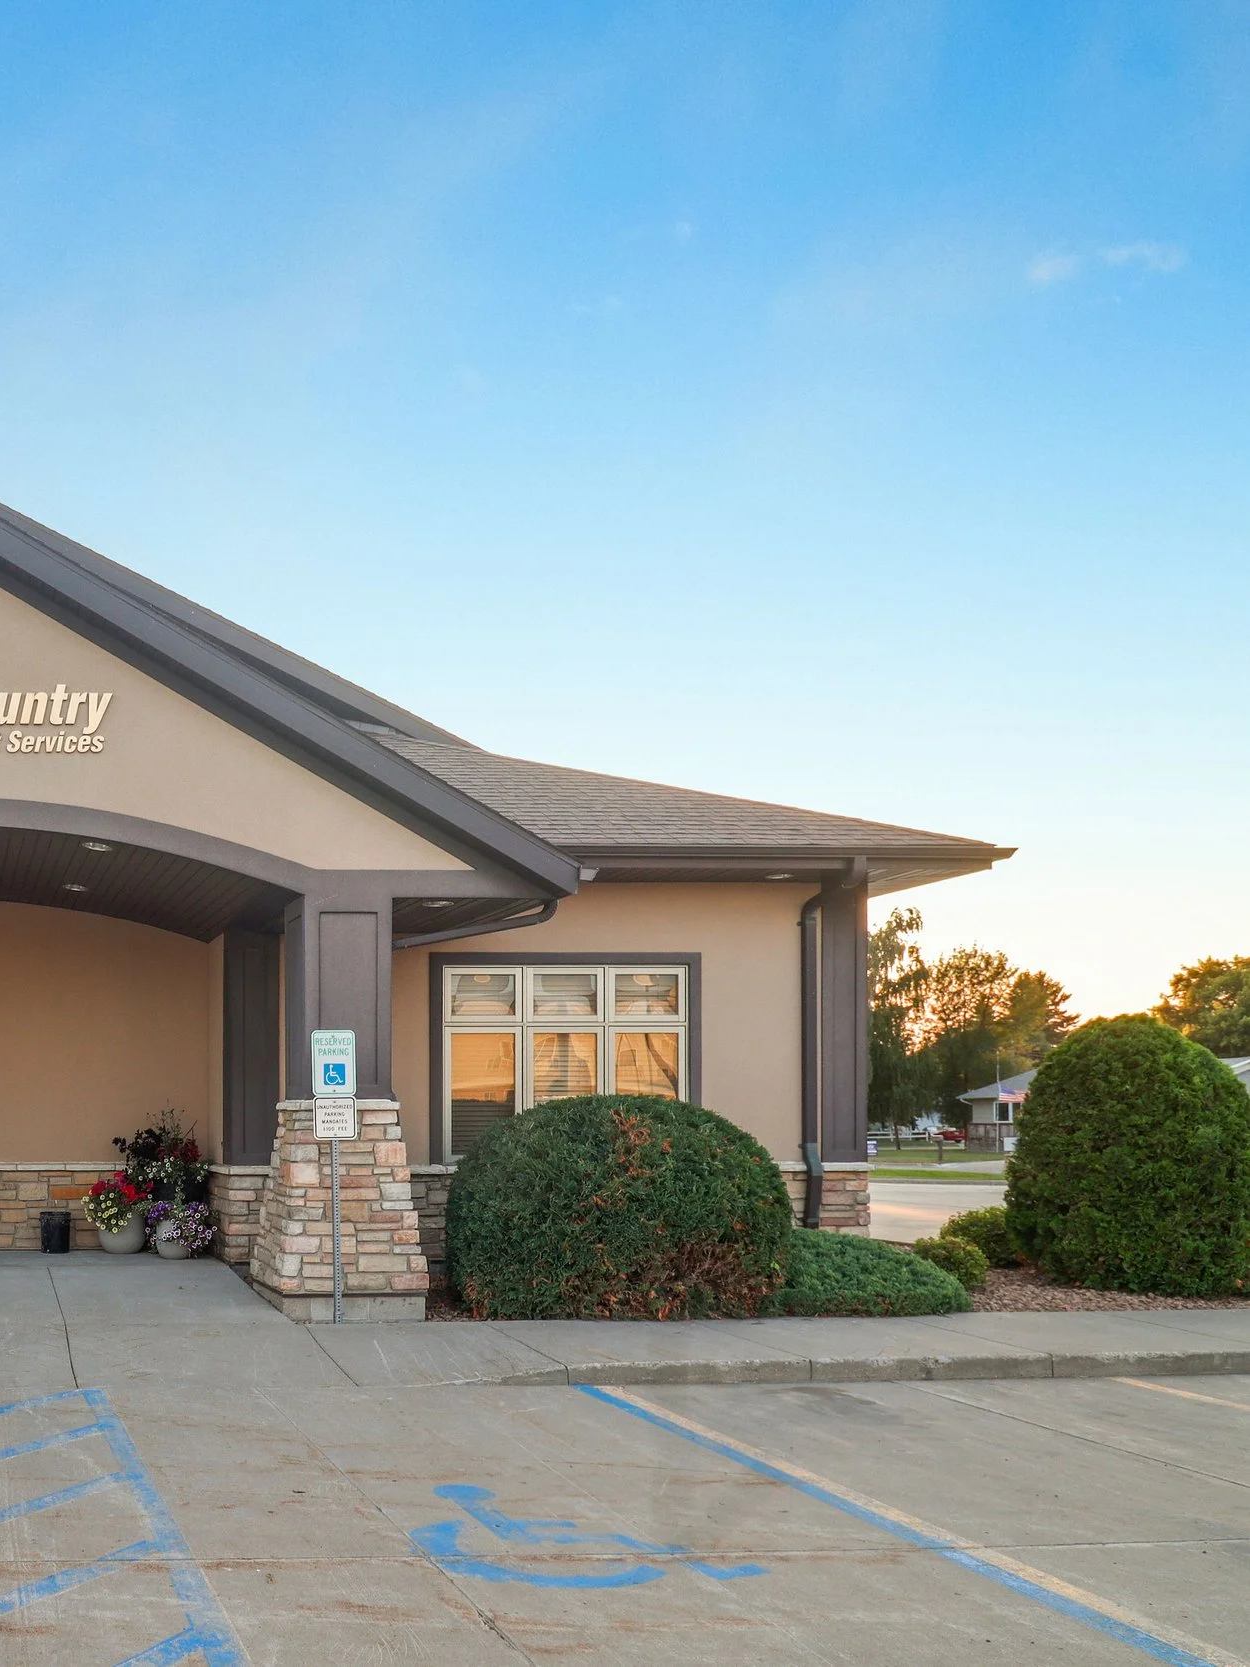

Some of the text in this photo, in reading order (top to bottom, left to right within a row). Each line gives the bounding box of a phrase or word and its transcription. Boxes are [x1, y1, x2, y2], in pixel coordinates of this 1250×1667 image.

[6, 730, 105, 754] Services
[315, 1037, 352, 1046] RESERVED
[318, 1048, 350, 1056] PARKING
